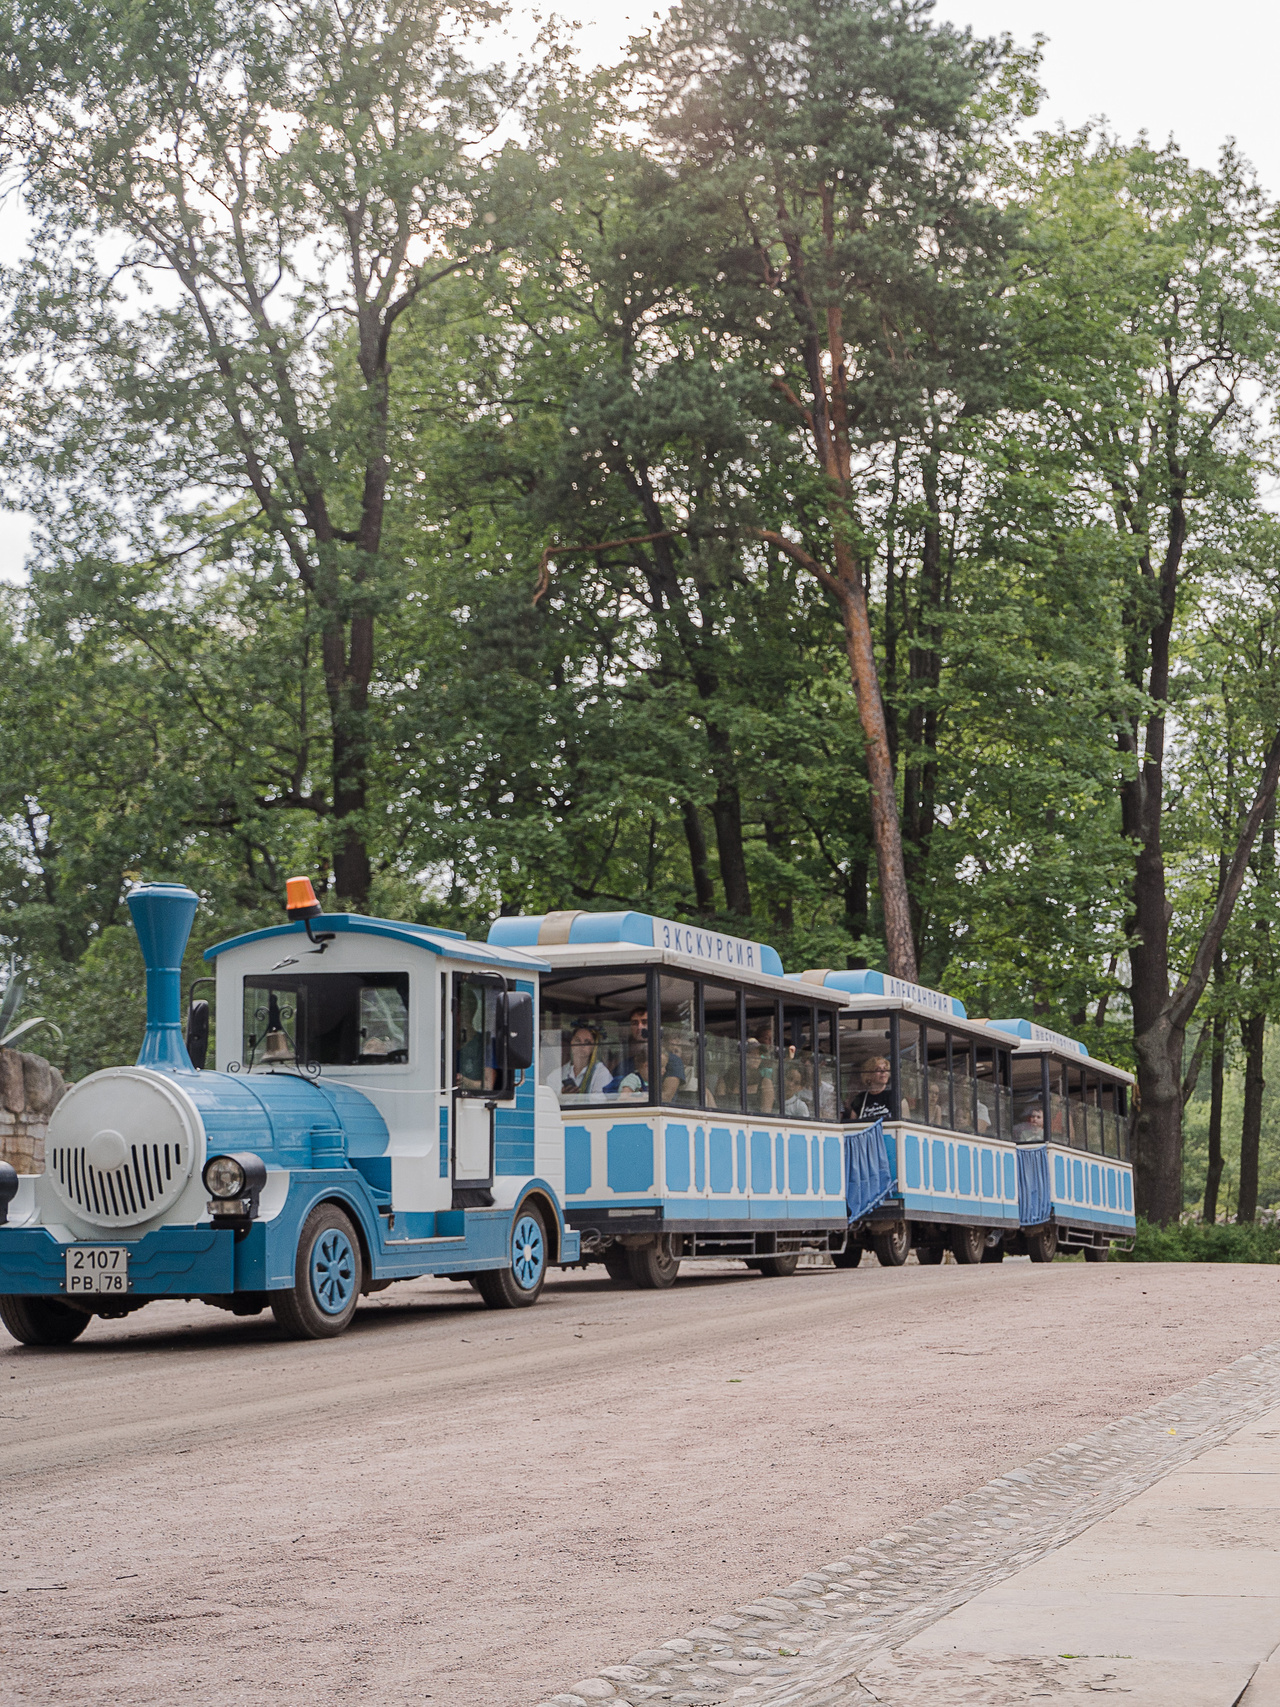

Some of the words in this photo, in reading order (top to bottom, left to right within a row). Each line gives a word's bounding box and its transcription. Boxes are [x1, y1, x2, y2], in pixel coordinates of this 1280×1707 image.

[663, 925, 755, 968] ЭКСКУРСИЯ
[73, 1250, 120, 1269] 2107
[104, 1276, 122, 1290] 78
